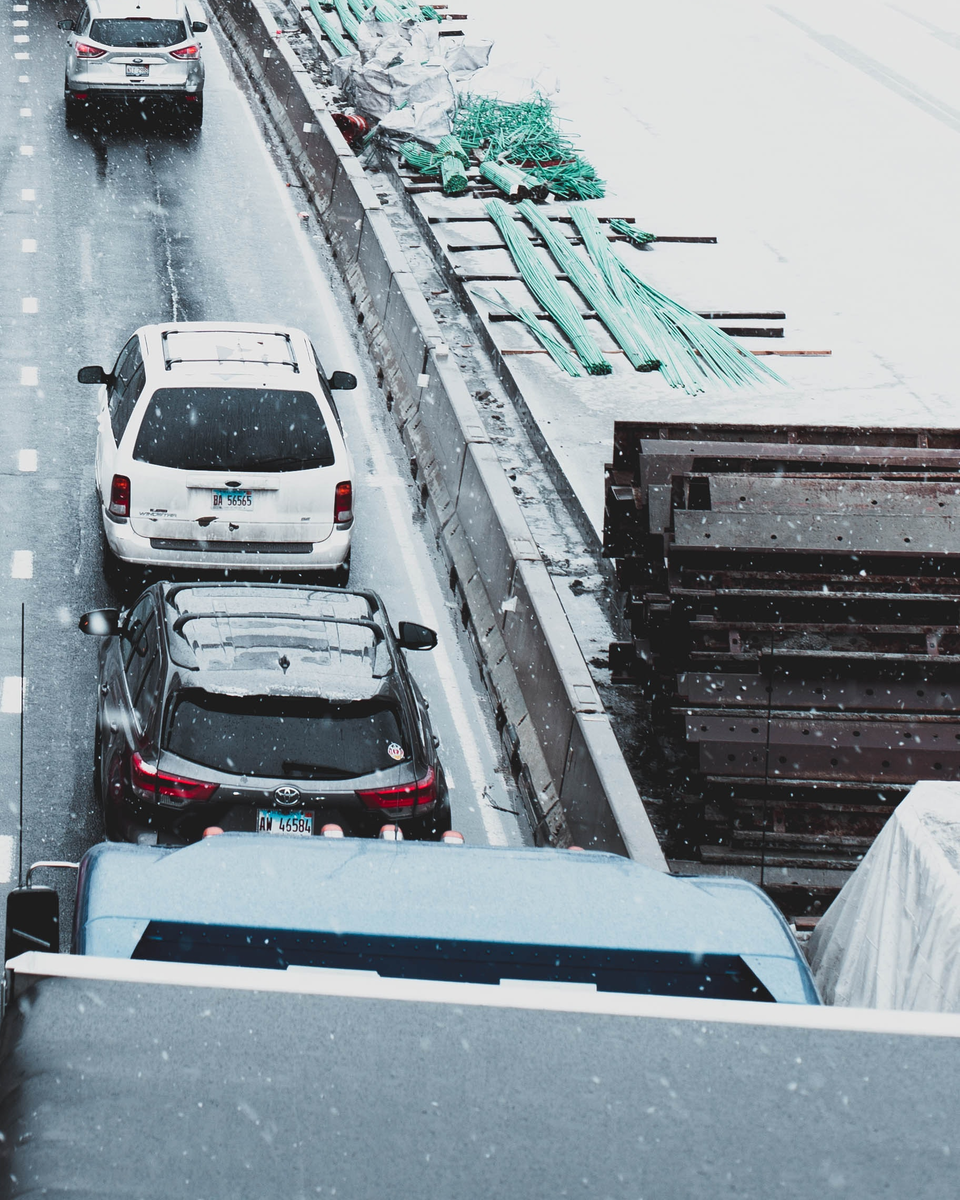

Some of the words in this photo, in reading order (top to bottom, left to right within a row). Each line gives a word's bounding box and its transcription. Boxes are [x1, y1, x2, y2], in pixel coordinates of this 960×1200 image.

[213, 494, 222, 506] BA
[227, 494, 252, 506] 56565
[259, 816, 272, 831] AW
[279, 817, 311, 833] 46584
